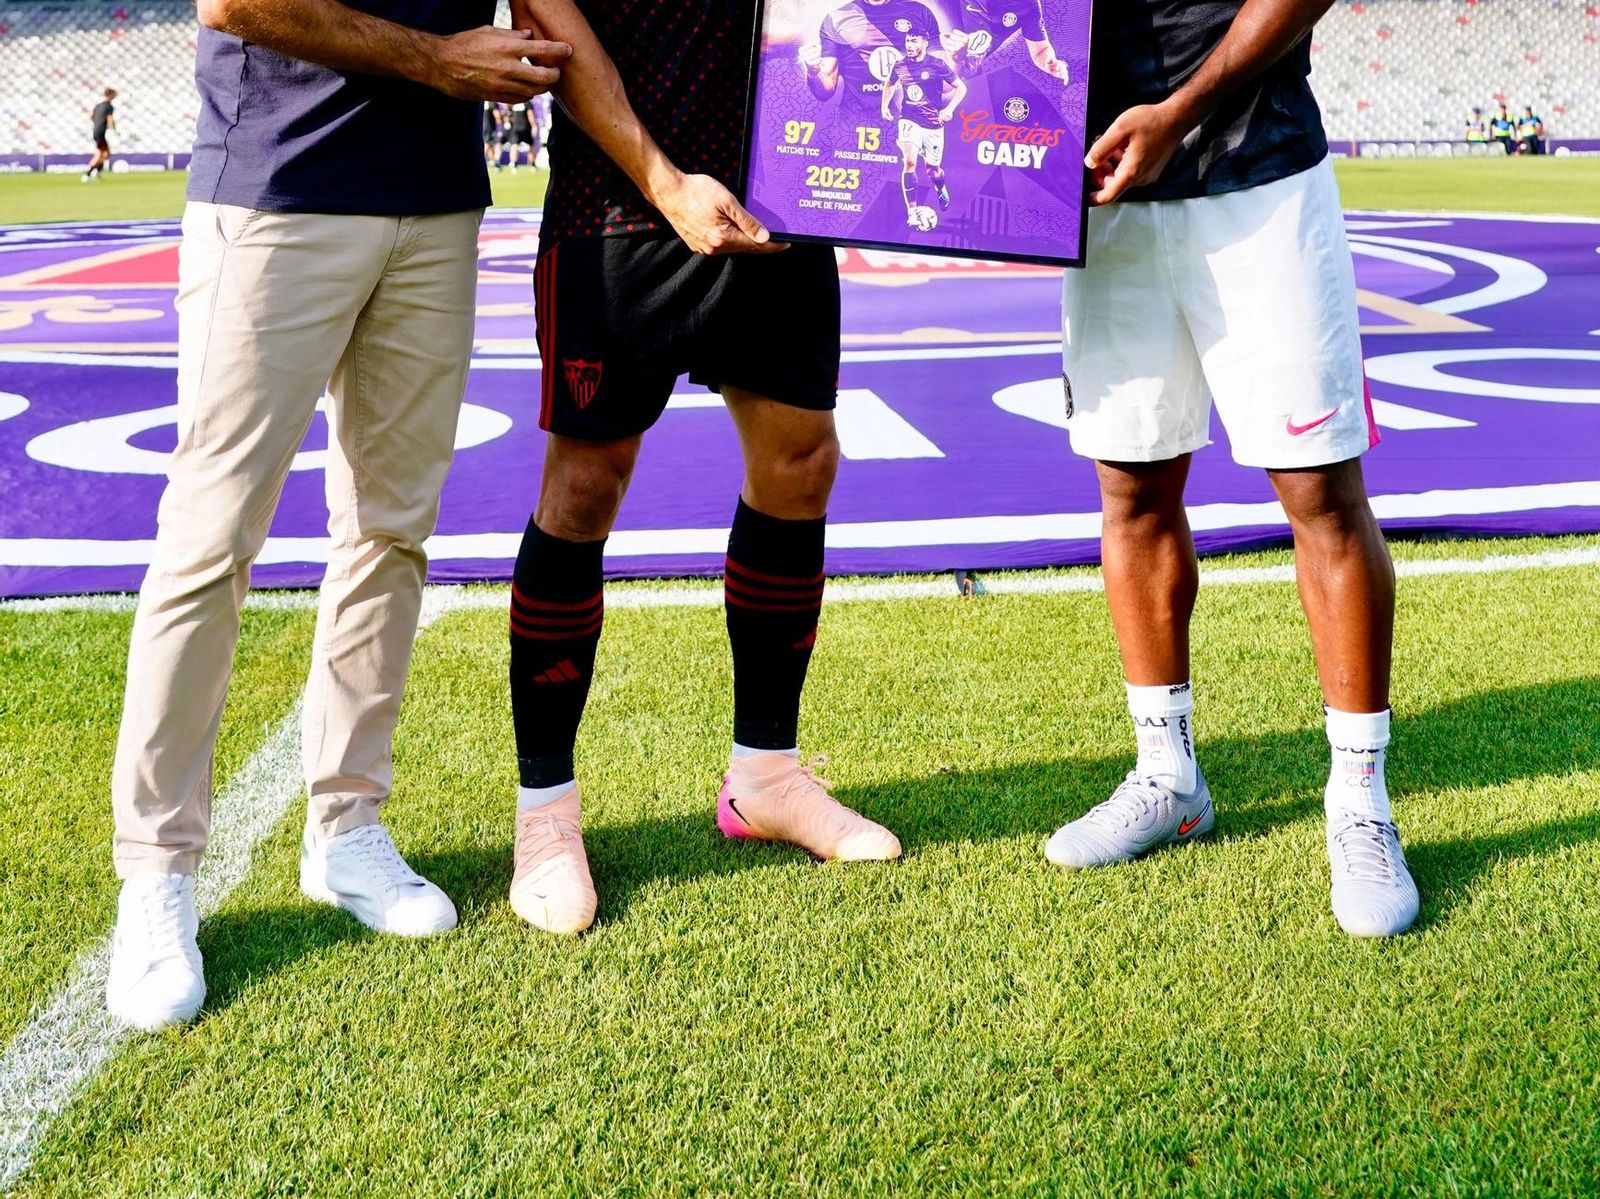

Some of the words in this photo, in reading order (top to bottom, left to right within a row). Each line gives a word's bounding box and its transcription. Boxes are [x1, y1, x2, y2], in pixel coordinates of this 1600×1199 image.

[784, 120, 816, 145] 97
[855, 126, 881, 151] 13
[959, 109, 1066, 148] Gracias
[776, 145, 805, 155] MATCHS
[805, 147, 820, 156] TCC
[834, 150, 861, 161] PASSES
[861, 152, 899, 164] DÉCISIVES
[976, 140, 1049, 170] GABY
[805, 165, 861, 190] 2023
[799, 199, 823, 209] COUPE
[823, 201, 834, 210] DE
[834, 202, 863, 213] FRANCE
[811, 189, 852, 201] VAINQUEUR
